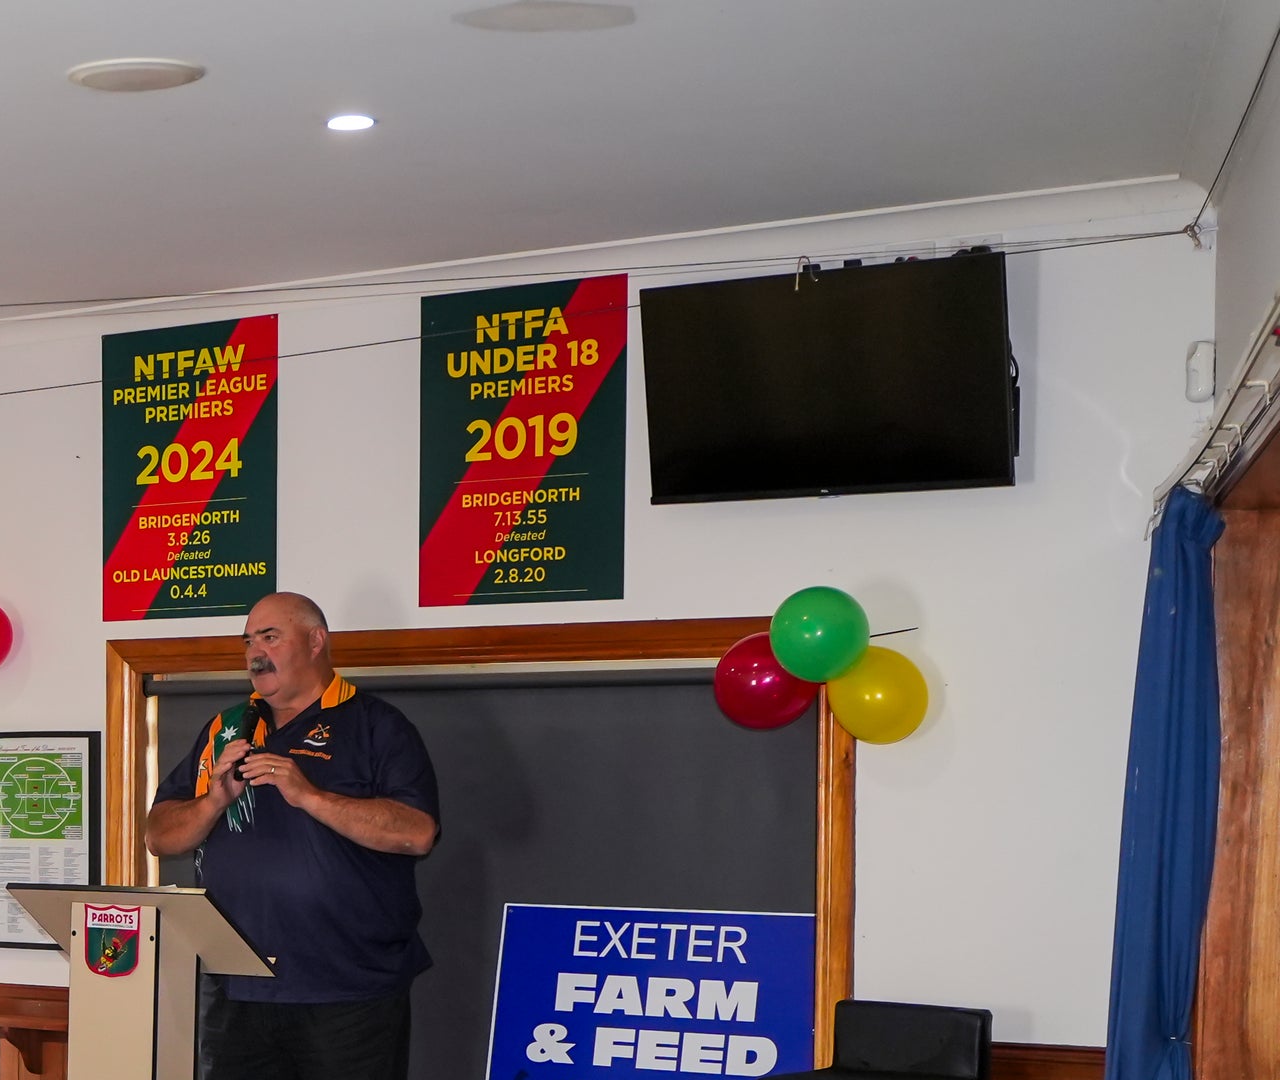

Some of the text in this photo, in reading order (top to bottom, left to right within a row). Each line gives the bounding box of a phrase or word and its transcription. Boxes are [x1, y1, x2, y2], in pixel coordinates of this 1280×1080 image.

[476, 306, 569, 344] NTFA
[134, 343, 245, 383] NTFAW
[447, 338, 599, 379] UNDER 18
[113, 374, 266, 405] PREMIER LEAGUE
[470, 374, 574, 400] PREMIERS
[144, 399, 233, 424] PREMIERS
[465, 412, 578, 463] 2019
[135, 437, 243, 486] 2024
[462, 487, 581, 509] BRIDGENORTH
[139, 510, 240, 529] BRIDGENORTH
[494, 508, 548, 527] 7.13.55
[167, 529, 212, 547] 3.8.26
[495, 528, 548, 543] Defeated
[167, 549, 212, 562] Defeated
[475, 545, 567, 564] LONGFORD
[113, 561, 267, 583] OLD LAUNCESTONIANS
[493, 566, 547, 586] 2.8.20
[169, 583, 208, 600] 0.4.4
[91, 912, 134, 925] PARROTS
[574, 921, 746, 963] EXETER
[555, 973, 758, 1022] FARM
[527, 1024, 777, 1076] & FEED
